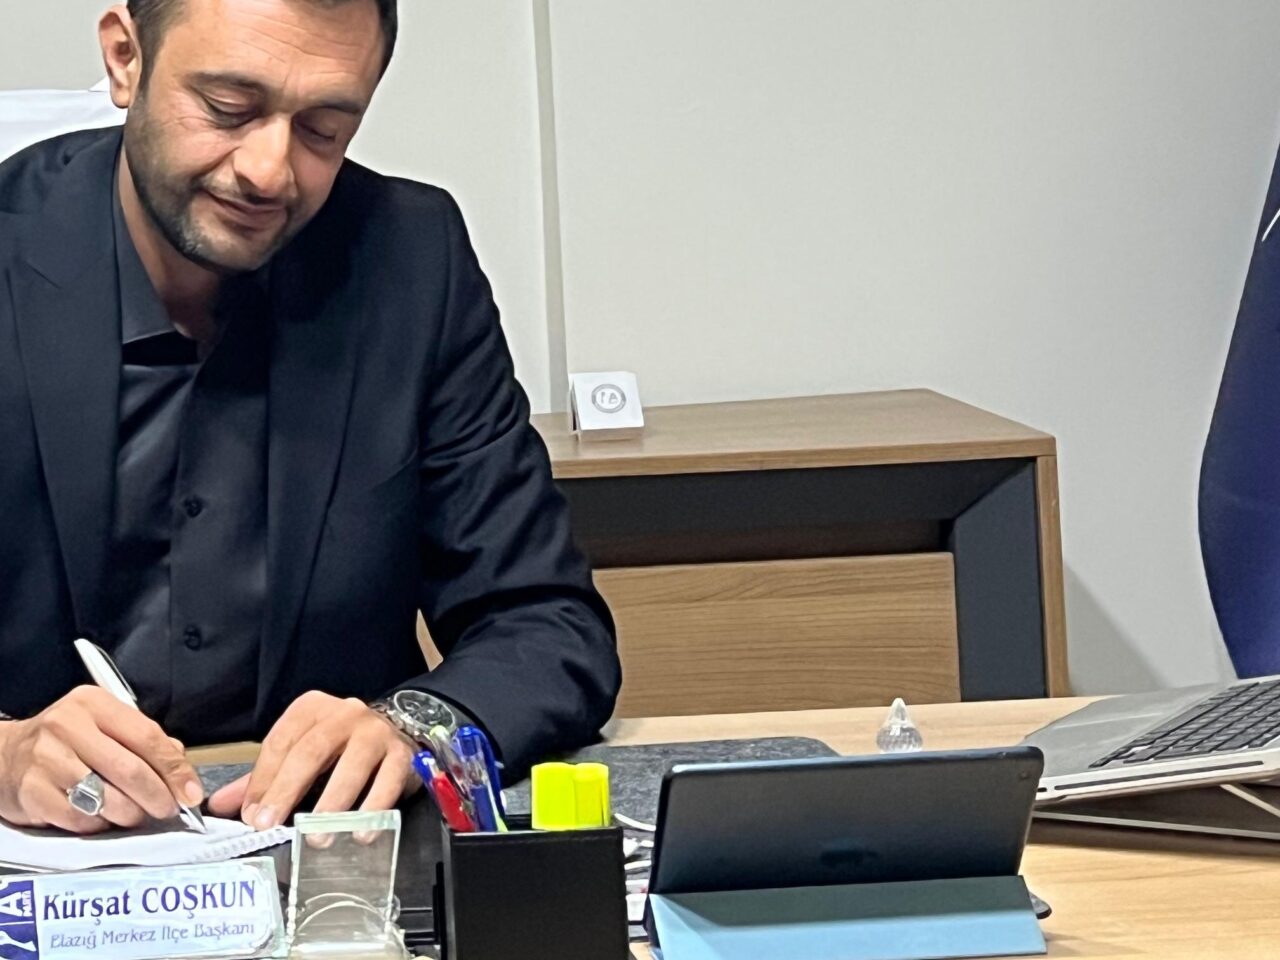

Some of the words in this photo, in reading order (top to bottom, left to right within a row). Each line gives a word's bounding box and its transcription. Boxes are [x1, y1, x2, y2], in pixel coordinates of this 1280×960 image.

[43, 890, 132, 926] Kürşat
[141, 880, 256, 920] COŞKUN
[50, 931, 97, 949] Elazığ
[102, 928, 157, 945] Merkez
[194, 921, 255, 941] Başkanı
